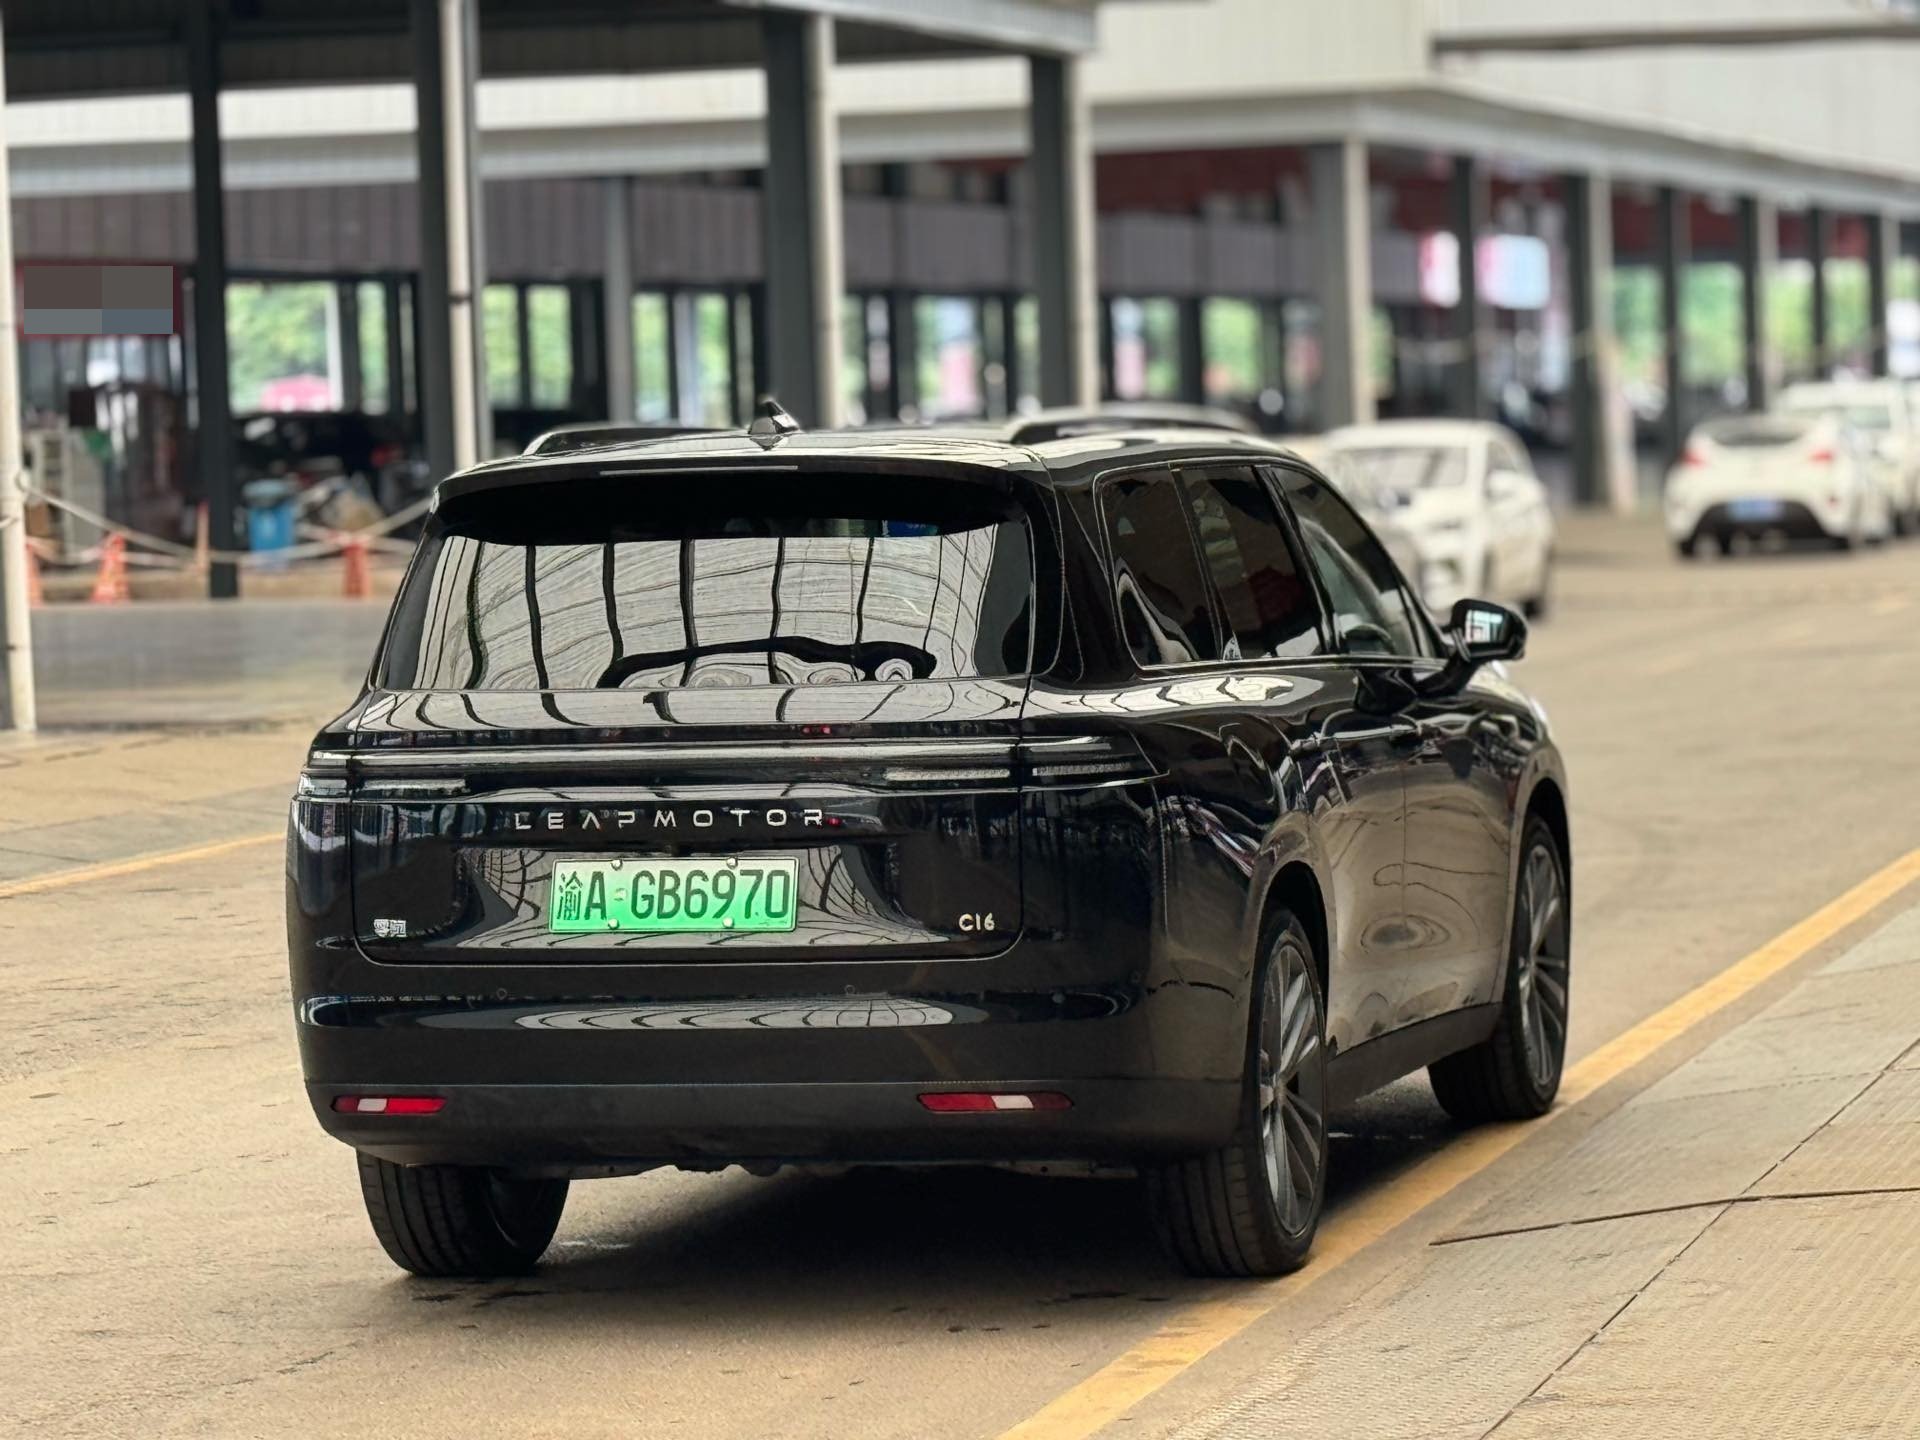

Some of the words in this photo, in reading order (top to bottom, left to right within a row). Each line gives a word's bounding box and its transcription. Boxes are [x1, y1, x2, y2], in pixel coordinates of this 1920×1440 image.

[514, 808, 823, 830] LEAPMOTOR
[630, 869, 791, 920] GB6970
[958, 912, 996, 932] C16
